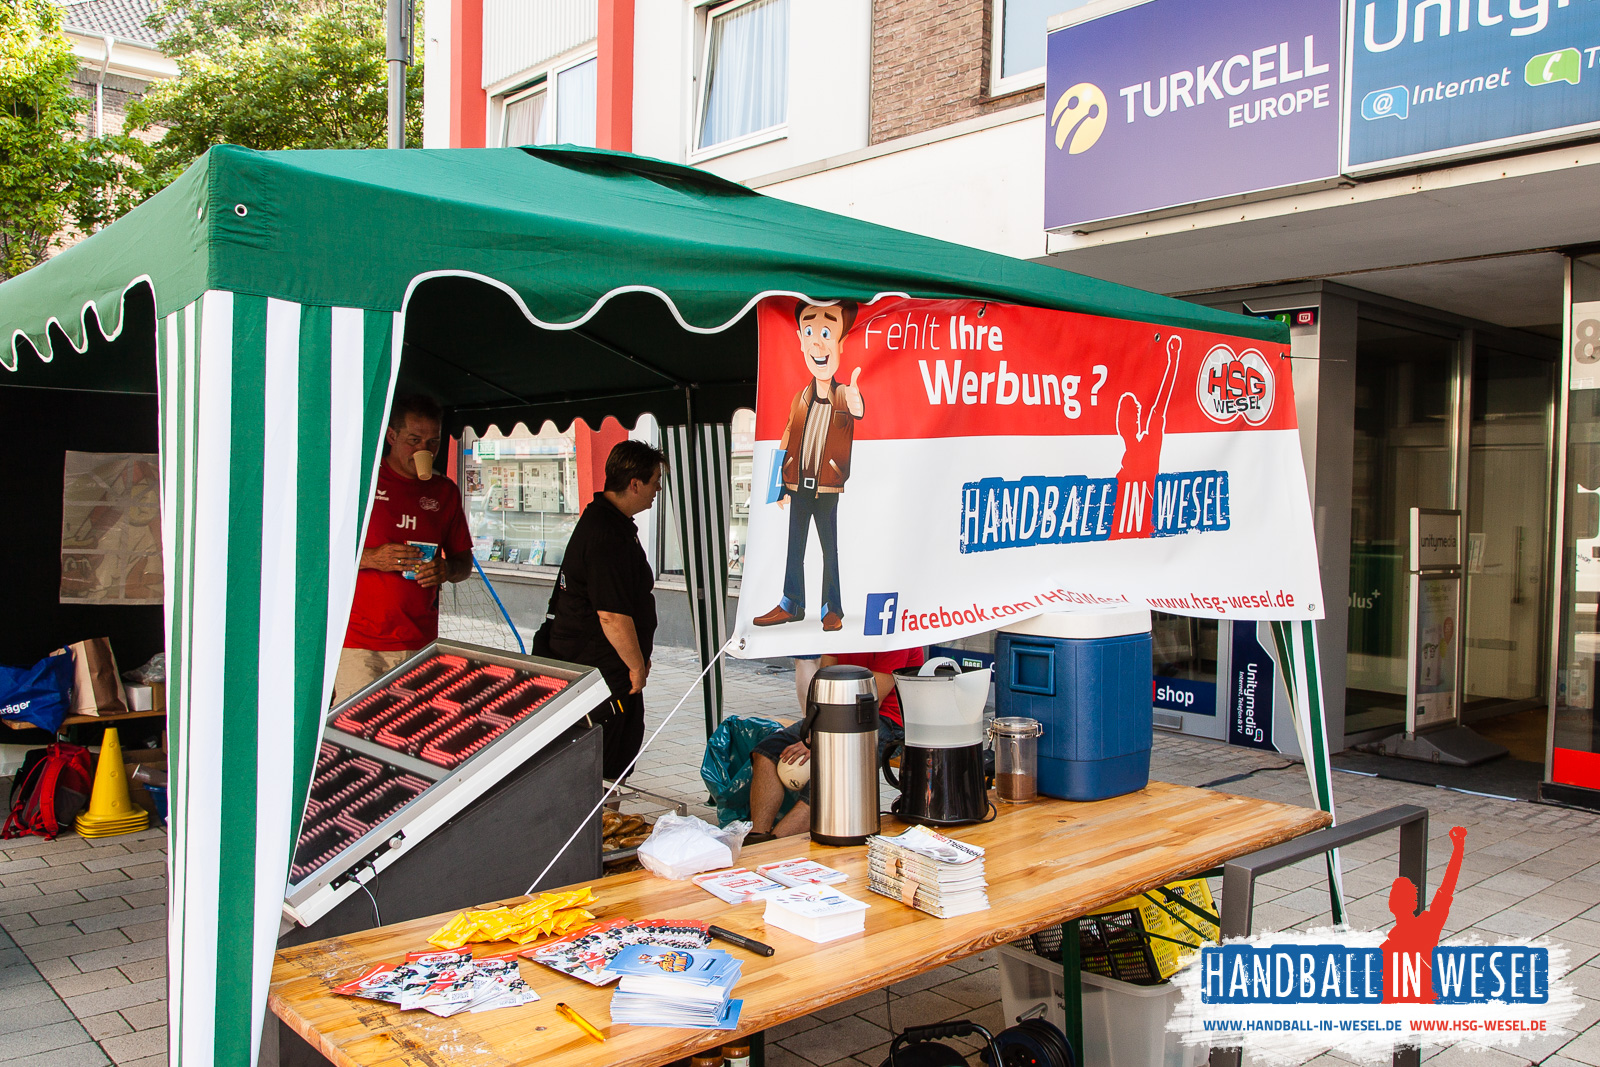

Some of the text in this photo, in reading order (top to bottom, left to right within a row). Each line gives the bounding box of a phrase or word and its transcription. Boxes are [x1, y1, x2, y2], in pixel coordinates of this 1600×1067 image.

[1584, 46, 1600, 69] T
[1120, 35, 1330, 123] TURKCELL
[1412, 66, 1512, 106] Internet
[1229, 84, 1330, 128] EUROPE
[865, 312, 1004, 352] Fehlt Ihre
[918, 359, 1109, 420] Werbung ?
[1208, 360, 1267, 401] HSG
[1213, 395, 1261, 414] WESEL
[396, 514, 417, 531] JH
[964, 476, 1228, 545] HANDBALL IN WESEL
[1146, 589, 1295, 613] www.hsg-wesel.de
[1157, 685, 1194, 707] shop
[1244, 663, 1258, 736] Unitymedia
